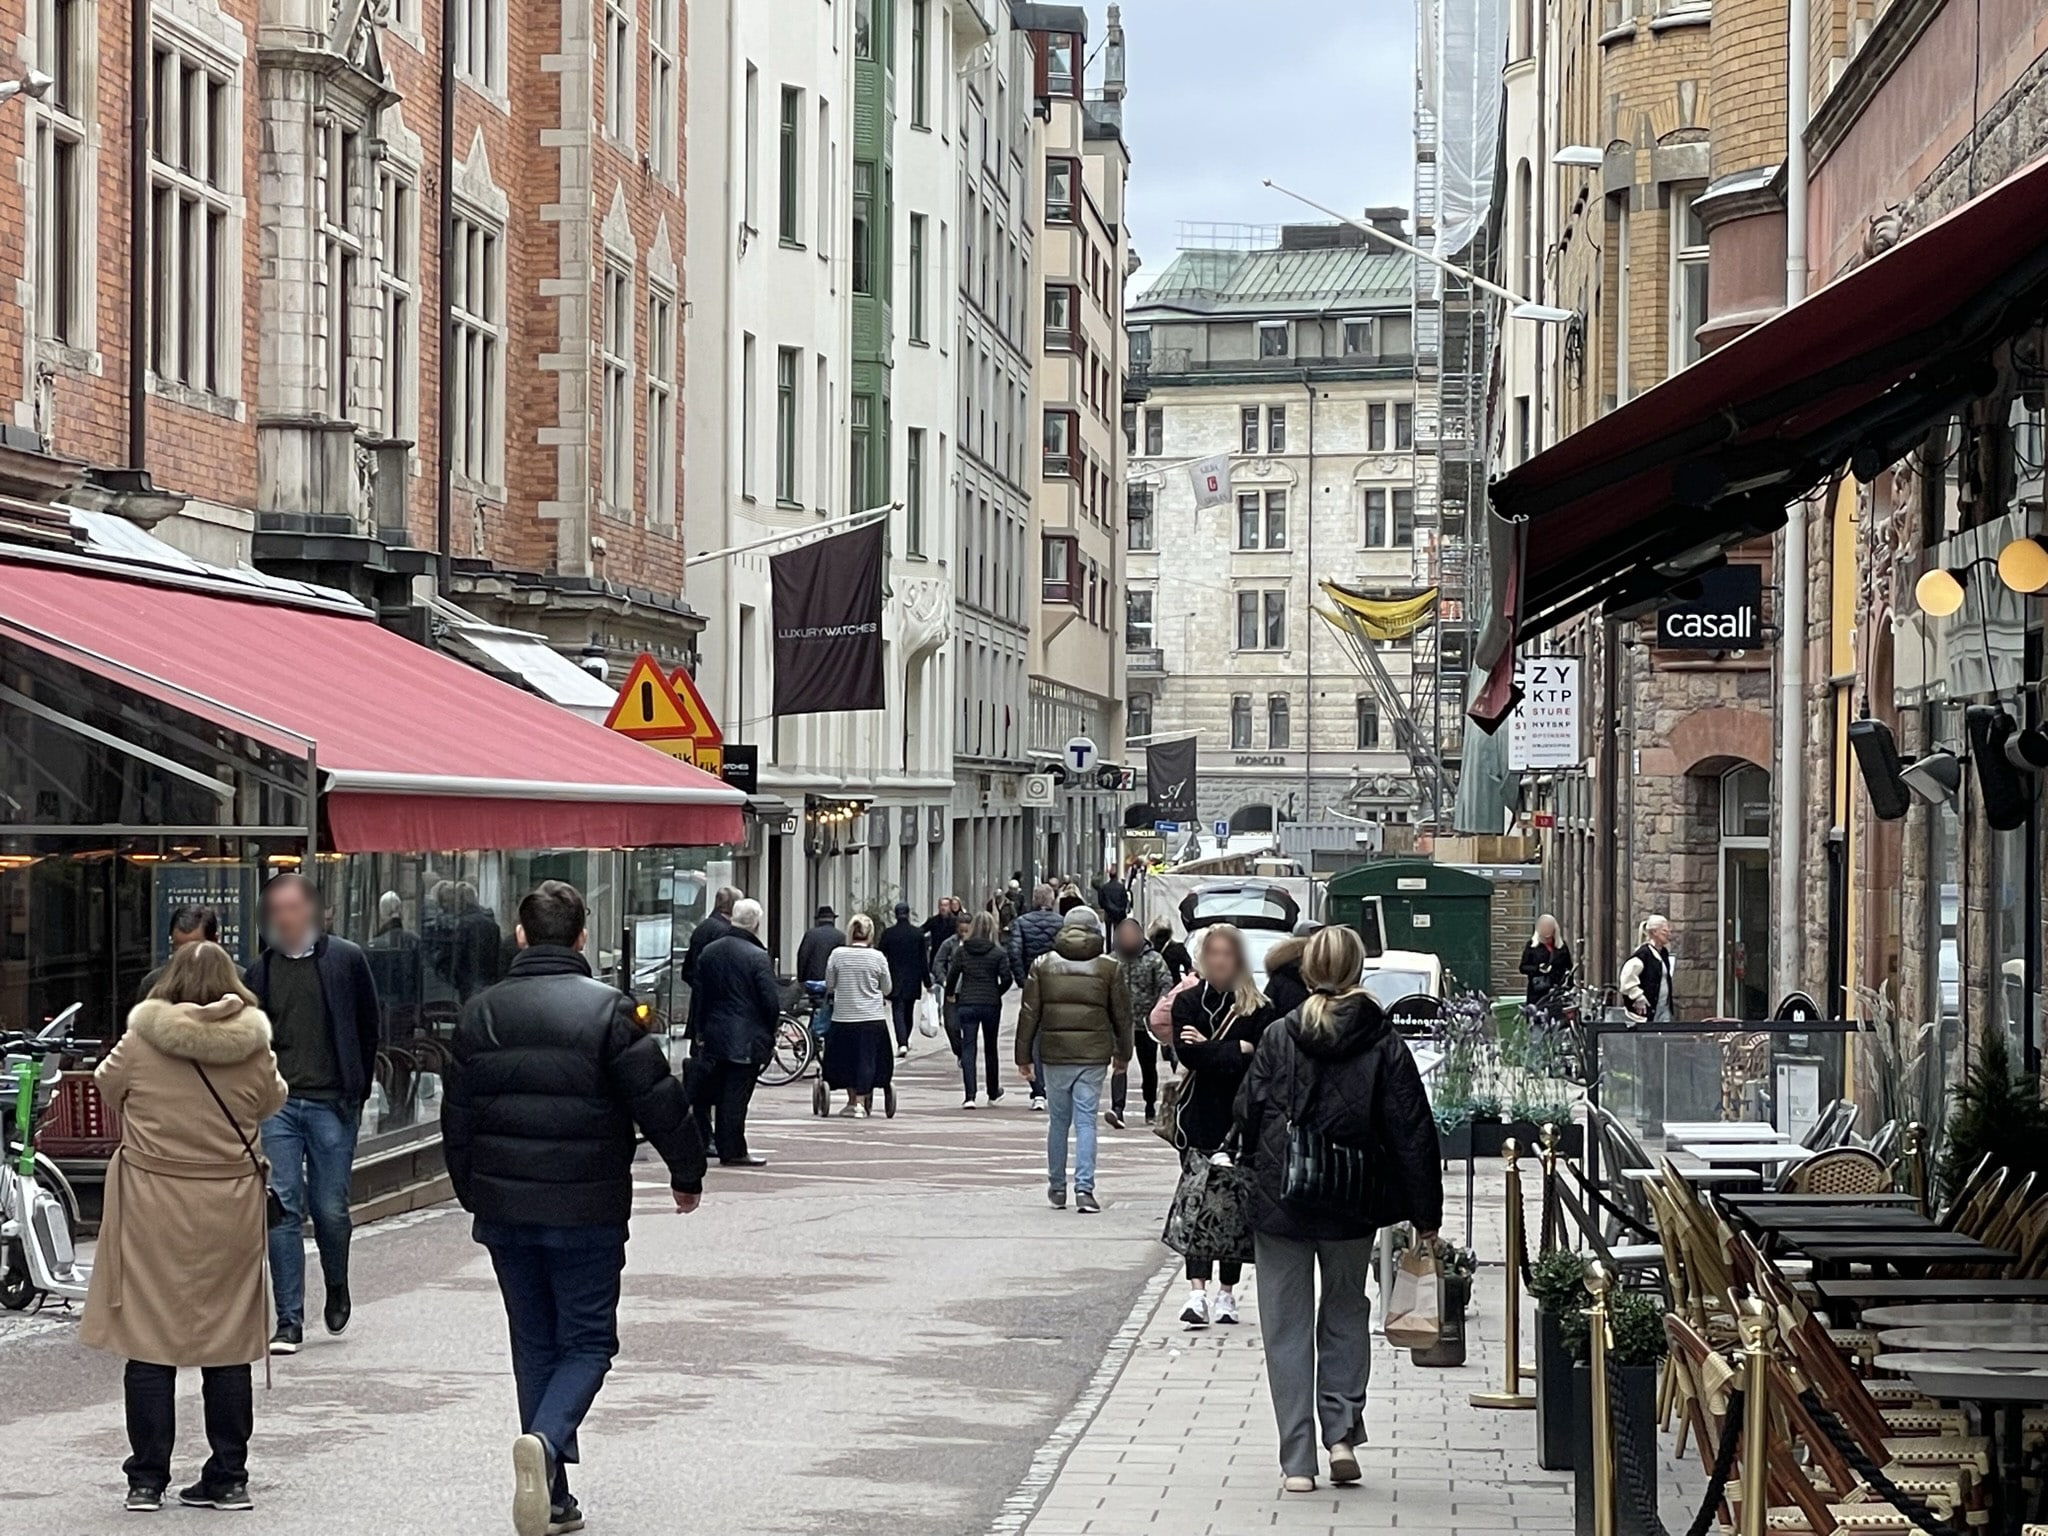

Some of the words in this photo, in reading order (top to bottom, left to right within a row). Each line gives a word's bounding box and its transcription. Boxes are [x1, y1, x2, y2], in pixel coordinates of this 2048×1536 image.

[1666, 605, 1751, 638] casall
[778, 622, 877, 639] LUXURYWATCHES
[1532, 690, 1572, 702] KTP
[1532, 707, 1571, 716] STURE
[1069, 746, 1091, 768] T
[1235, 756, 1286, 767] MONCLER
[168, 896, 240, 904] EVENEMANG
